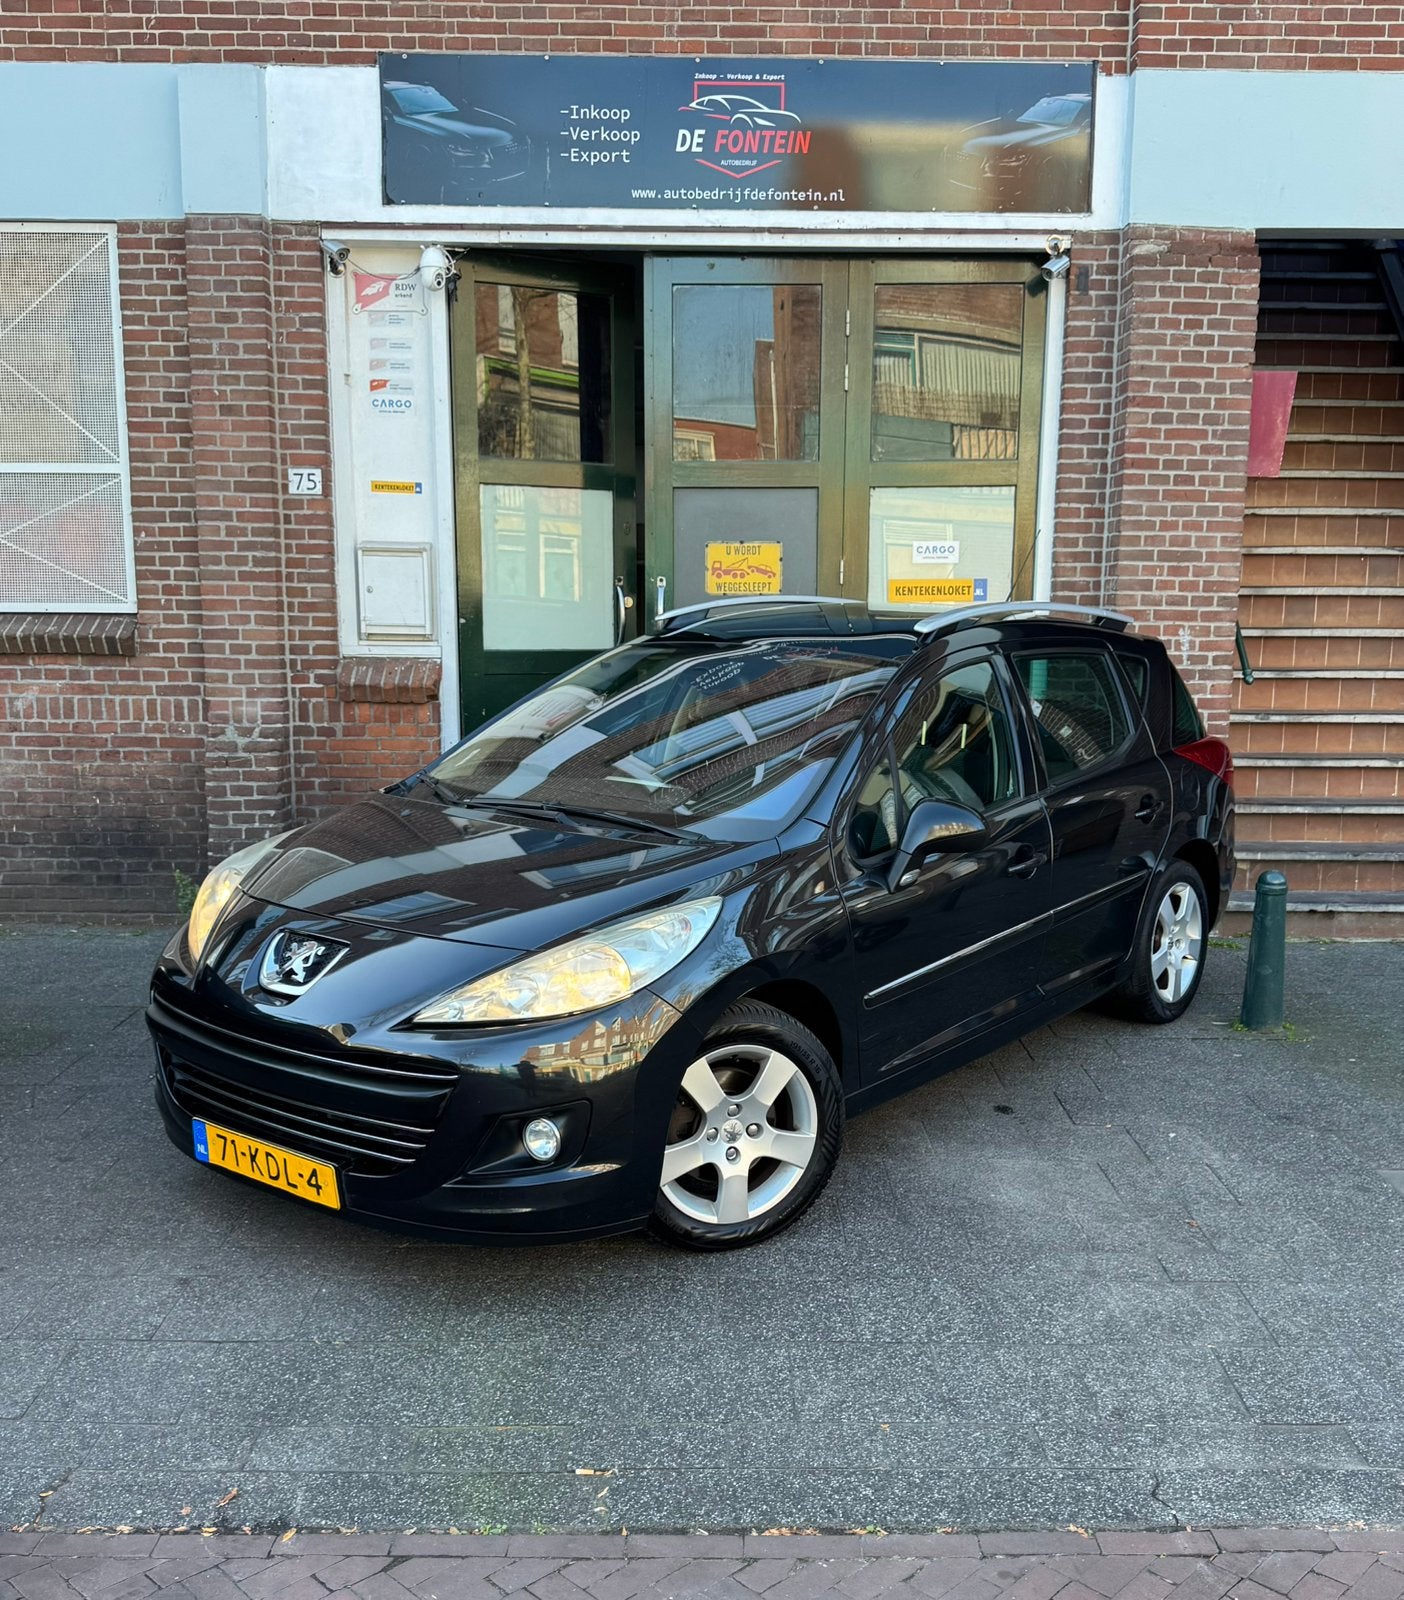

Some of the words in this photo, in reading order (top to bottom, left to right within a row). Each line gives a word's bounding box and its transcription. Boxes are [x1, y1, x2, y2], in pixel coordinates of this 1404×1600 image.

[675, 129, 706, 152] DE
[714, 130, 812, 154] FONTEIN
[631, 188, 845, 202] www.autobedrijfdefontein.nl
[395, 283, 416, 291] RDW
[372, 399, 412, 408] CARGO
[293, 473, 317, 490] 75
[726, 545, 732, 555] U
[734, 545, 762, 556] WORDT
[916, 545, 956, 554] CARGO
[715, 582, 772, 593] WEGGESLEEPT
[197, 1143, 207, 1155] NL
[216, 1133, 322, 1196] 71-KDL-4
